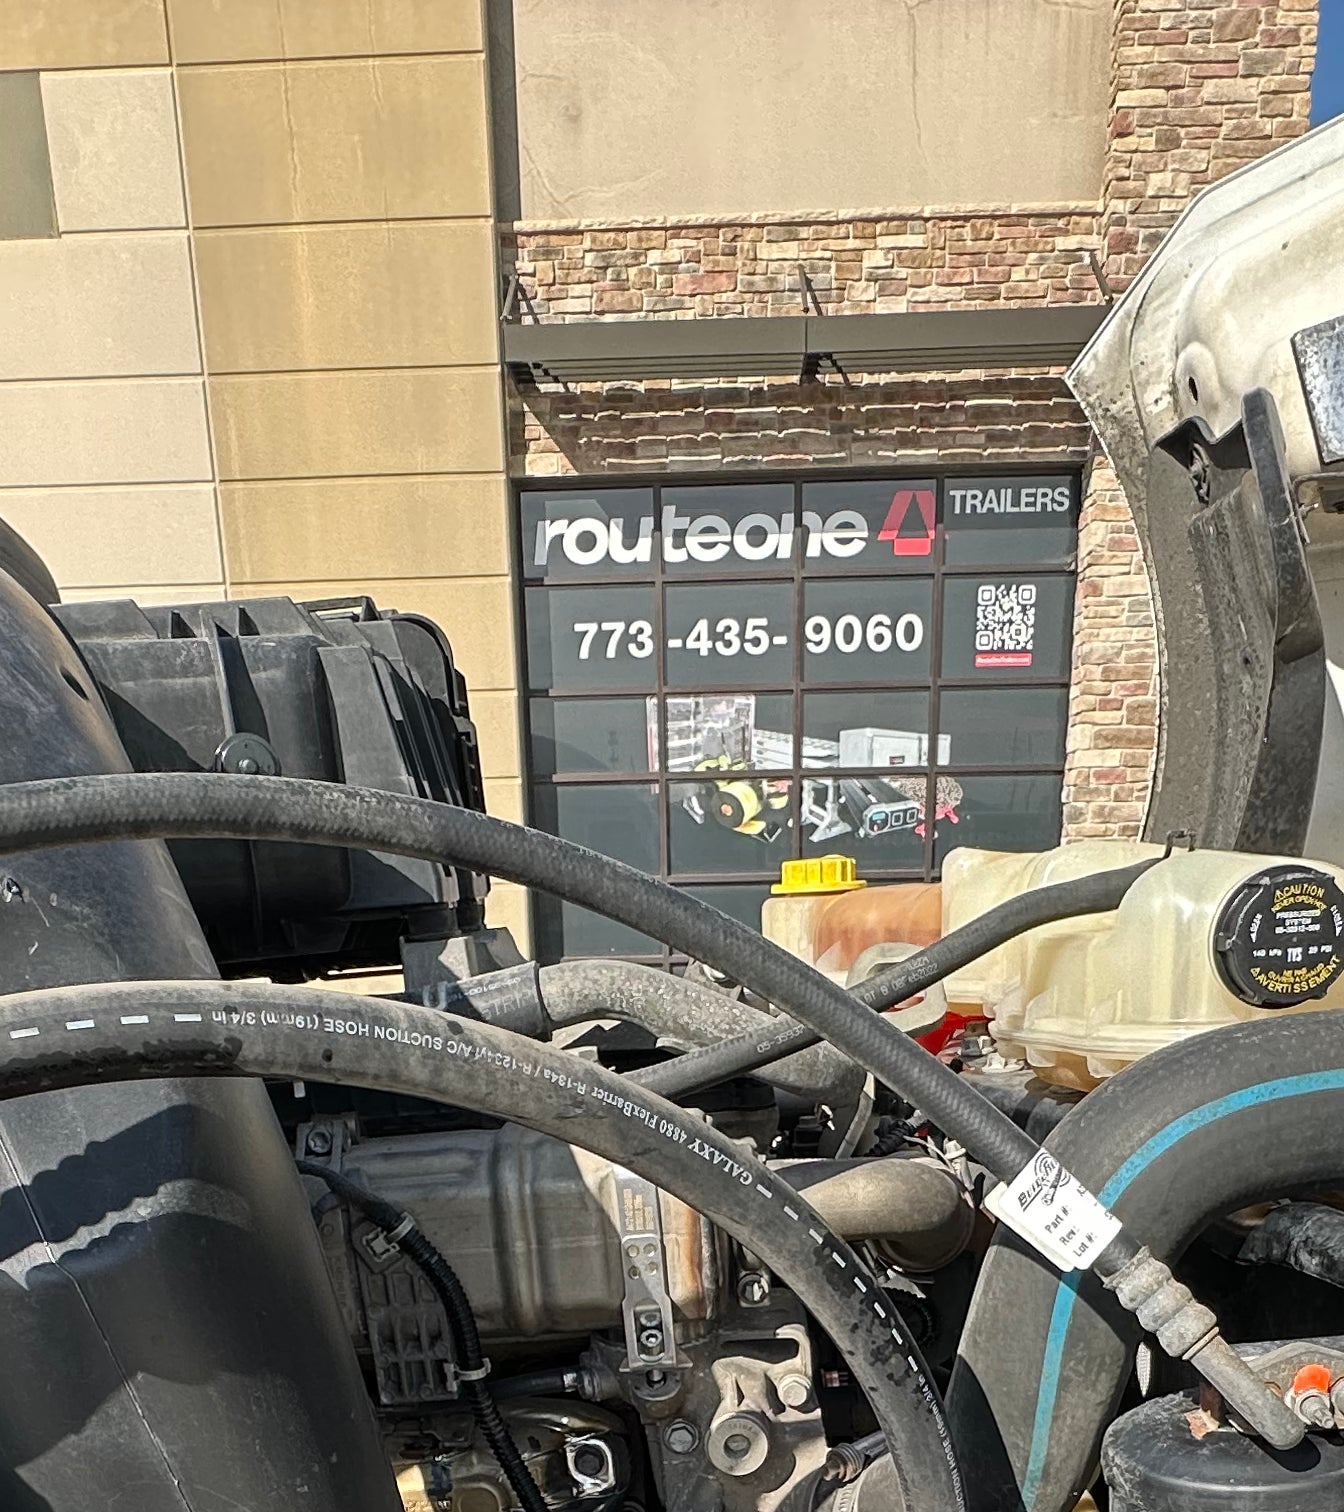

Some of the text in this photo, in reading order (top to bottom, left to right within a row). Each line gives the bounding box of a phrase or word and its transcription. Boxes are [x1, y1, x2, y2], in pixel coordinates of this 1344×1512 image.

[534, 486, 1070, 566] routeone TRAILERS
[1282, 883, 1325, 898] CAUTION
[1258, 954, 1341, 993] AVERTISSEMENT
[212, 1010, 226, 1025] in
[231, 1011, 256, 1025] 3/4
[260, 1010, 320, 1030] (19mm)
[323, 1018, 370, 1037] HOSE
[373, 1025, 444, 1051] SUCTION
[543, 1067, 587, 1096] R-134a
[591, 1085, 657, 1131] FlexBarrier
[659, 1118, 688, 1143] 4880
[687, 1137, 754, 1187] GALAXY
[1044, 1214, 1064, 1234] Part
[1058, 1225, 1080, 1246] Rev:
[1073, 1240, 1090, 1257] Lot
[941, 1437, 956, 1468] HOSE
